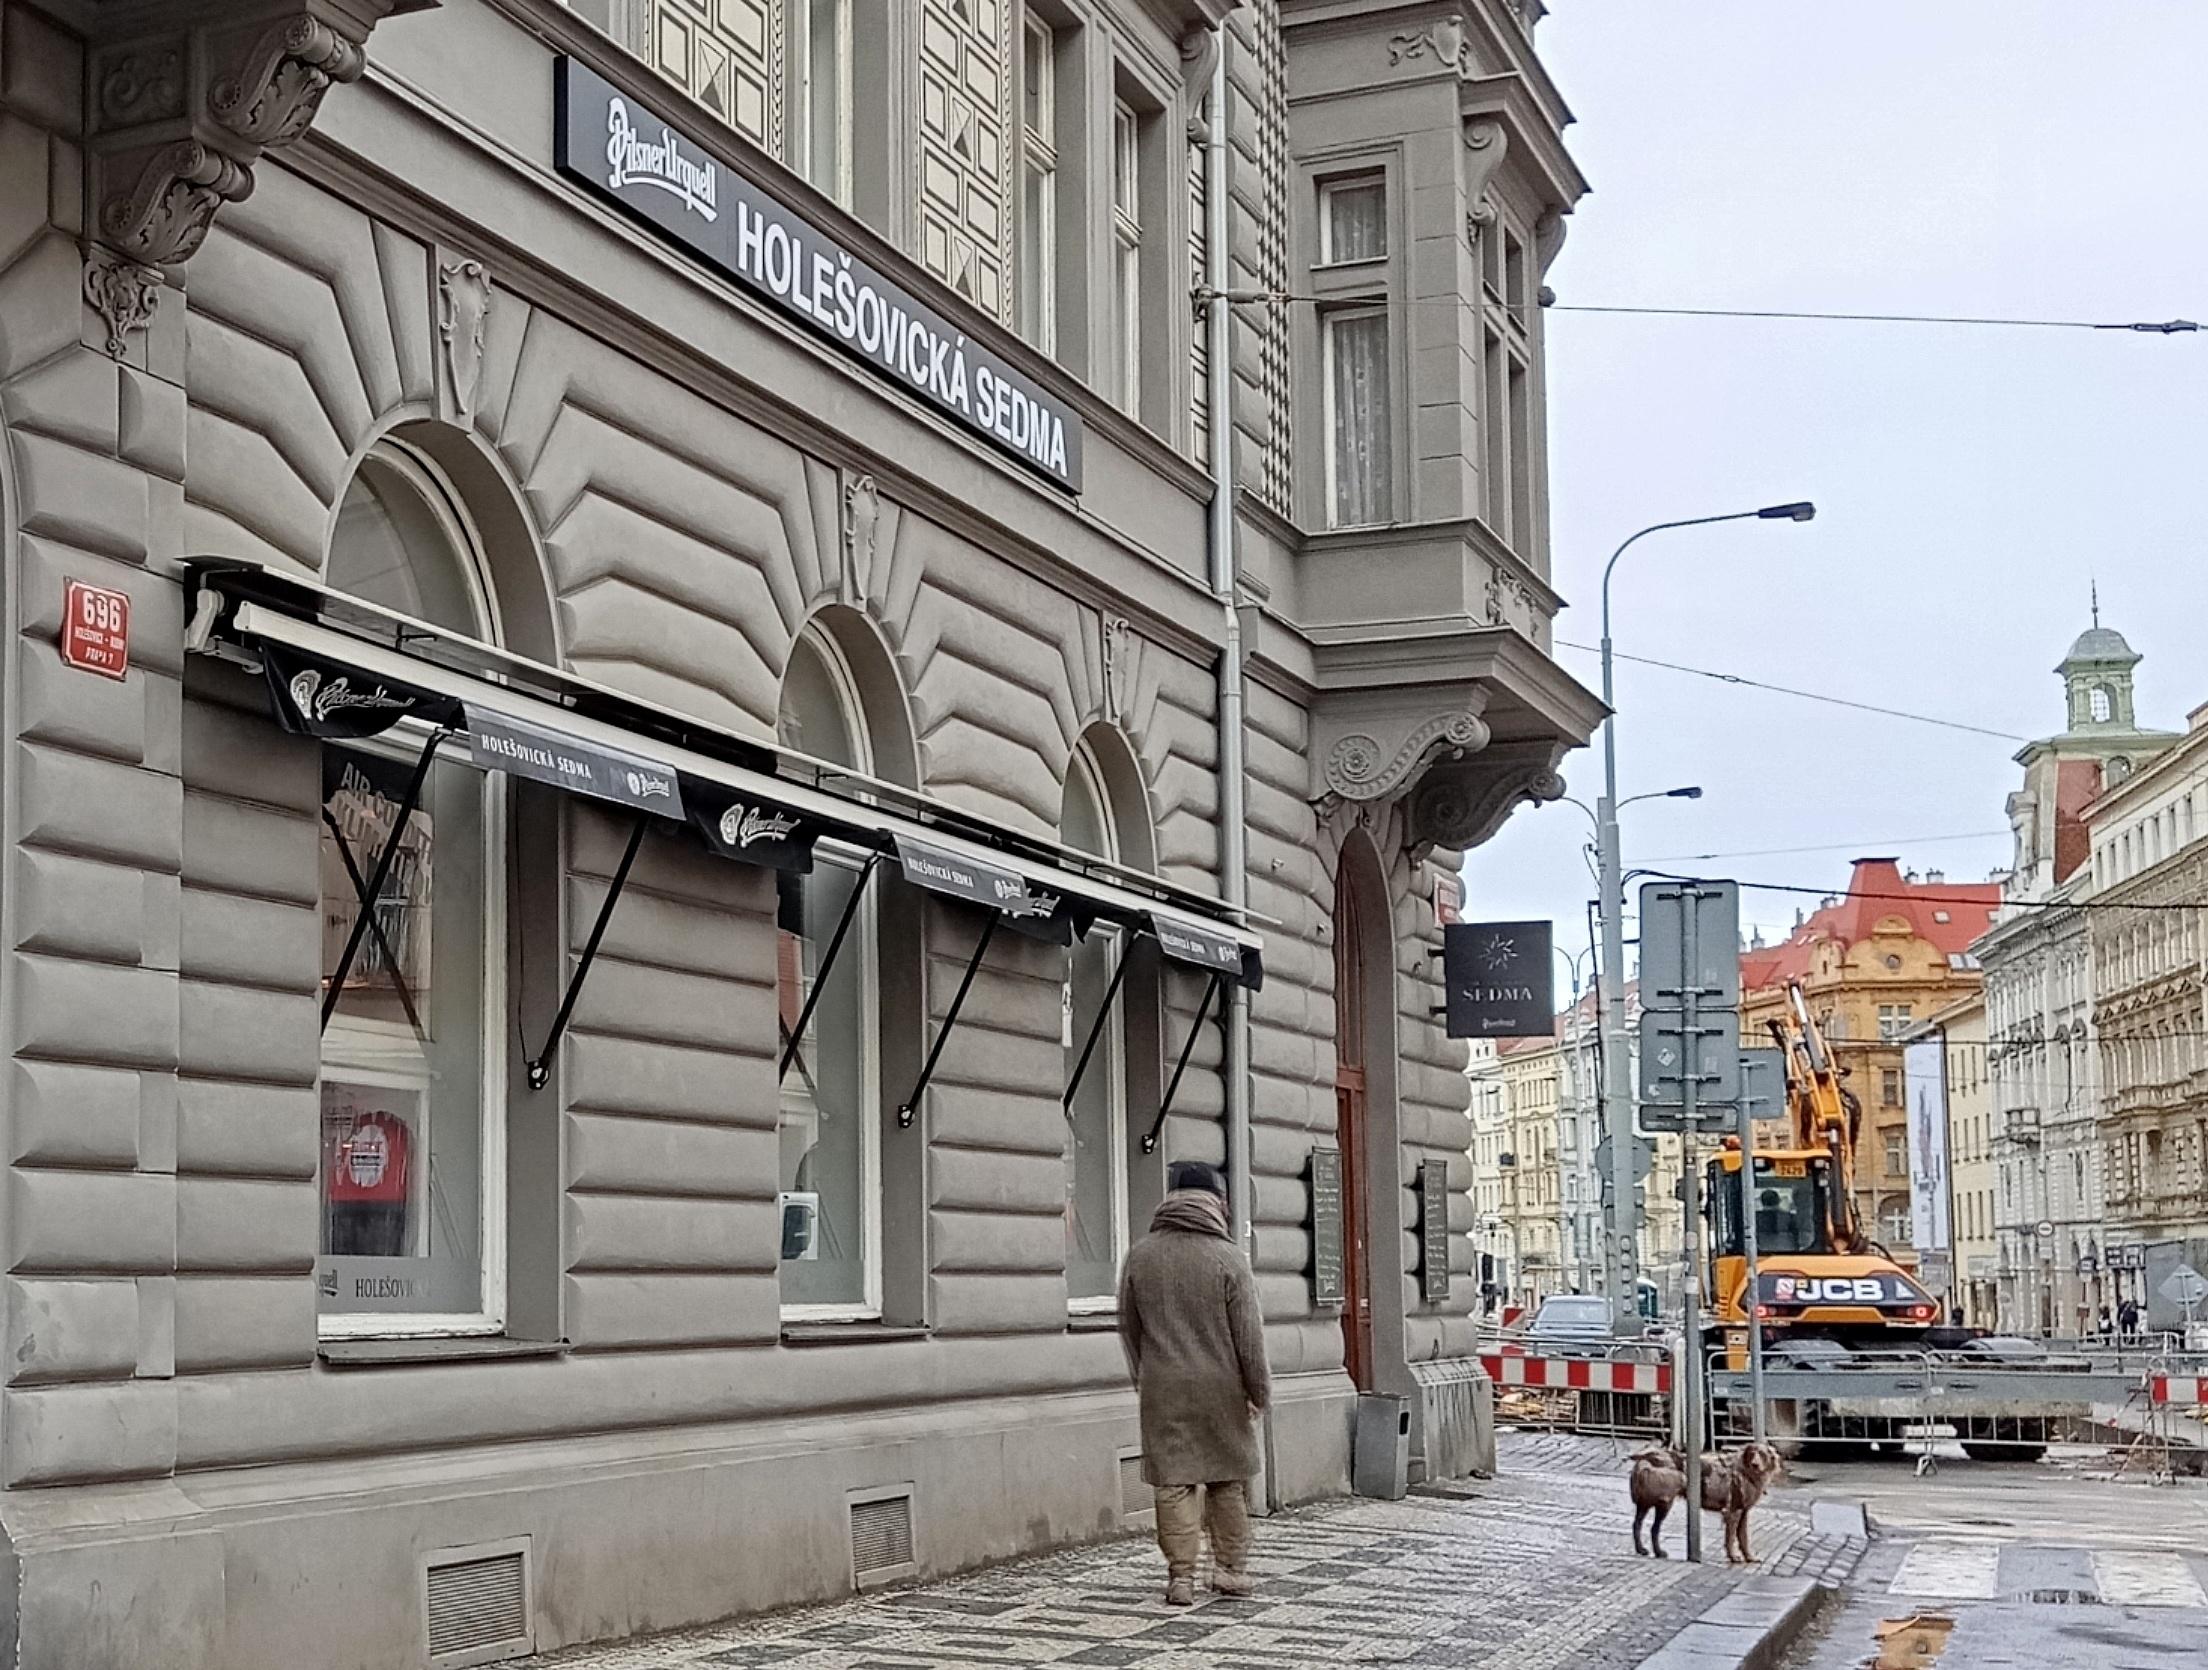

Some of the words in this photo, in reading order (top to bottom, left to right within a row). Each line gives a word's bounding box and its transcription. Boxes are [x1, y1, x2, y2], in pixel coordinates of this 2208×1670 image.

[607, 97, 666, 188] Pilsner
[661, 127, 717, 211] Urquell
[737, 200, 971, 416] HOLEŠOVICKÁ
[975, 364, 1068, 477] SEDMA
[83, 590, 121, 633] 696
[481, 733, 555, 769] HOLEŠOVICKÁ
[557, 756, 593, 780] SEDMA
[1462, 986, 1533, 1002] SEDMA
[1795, 1278, 1884, 1301] JCB
